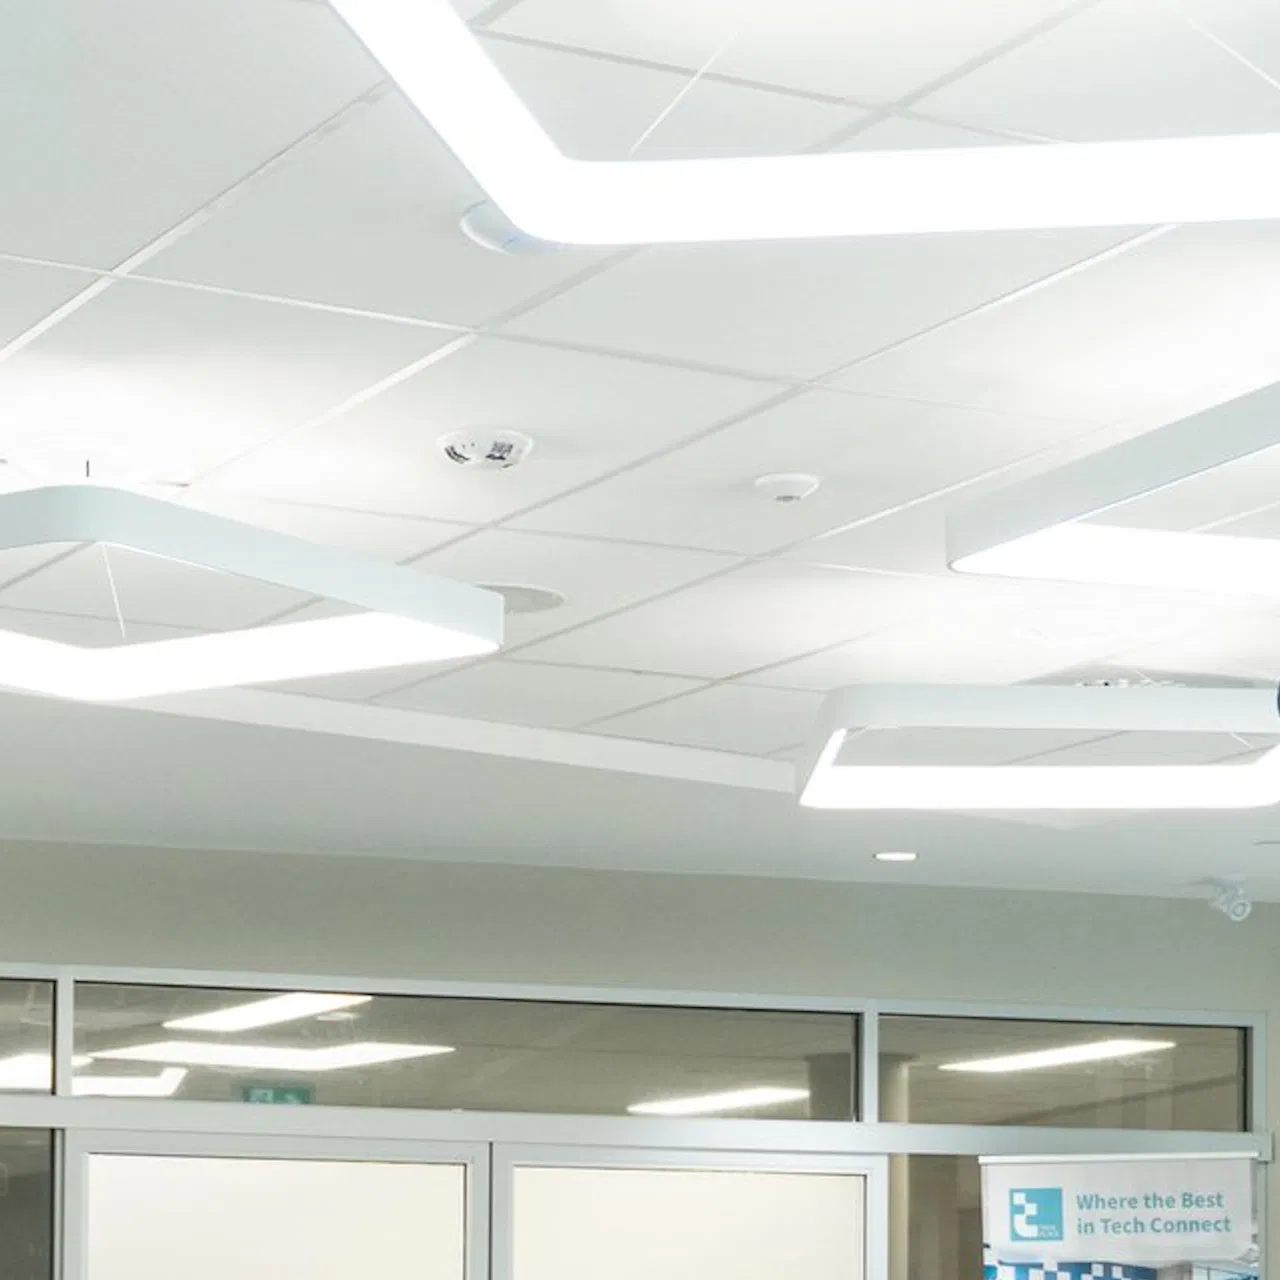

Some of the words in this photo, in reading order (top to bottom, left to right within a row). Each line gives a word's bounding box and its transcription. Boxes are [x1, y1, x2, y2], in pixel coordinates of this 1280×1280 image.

[1076, 1193, 1138, 1210] Where
[1142, 1192, 1176, 1209] the
[1181, 1191, 1225, 1208] Best
[1077, 1217, 1095, 1234] in
[1100, 1216, 1145, 1234] Tech
[1150, 1216, 1233, 1233] Connect
